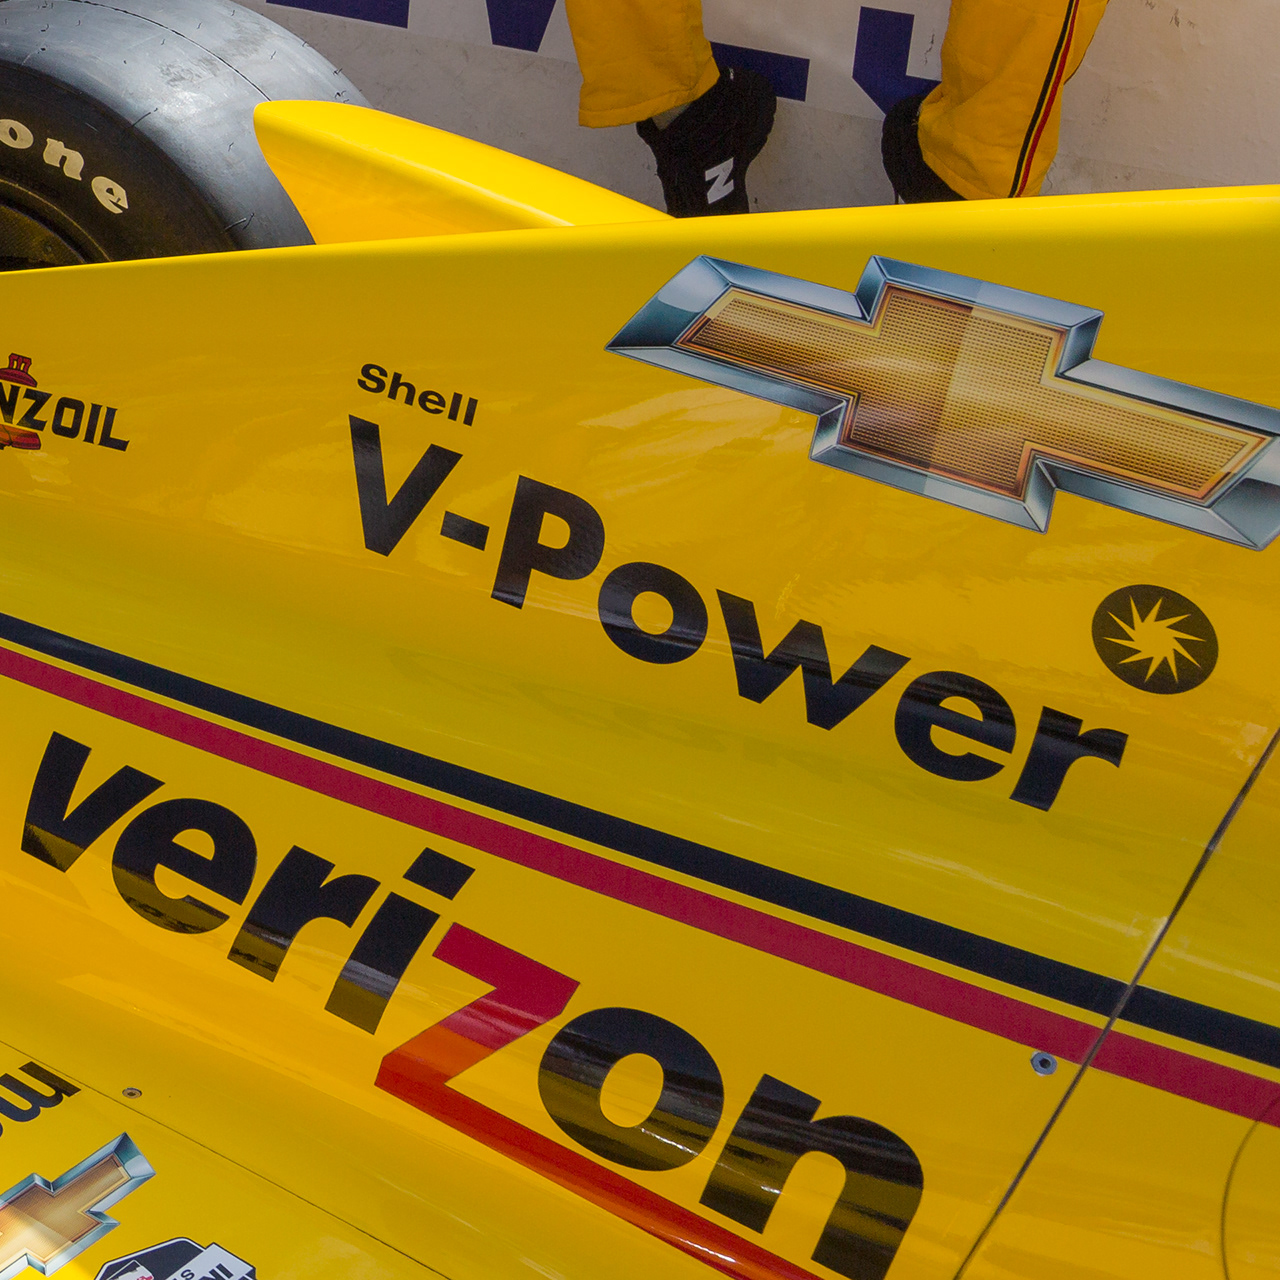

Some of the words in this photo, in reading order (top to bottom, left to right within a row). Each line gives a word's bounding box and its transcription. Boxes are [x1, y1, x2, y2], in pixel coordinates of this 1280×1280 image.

[357, 362, 478, 427] Shell
[348, 414, 1130, 813] V-Power
[20, 730, 926, 1280] verizon
